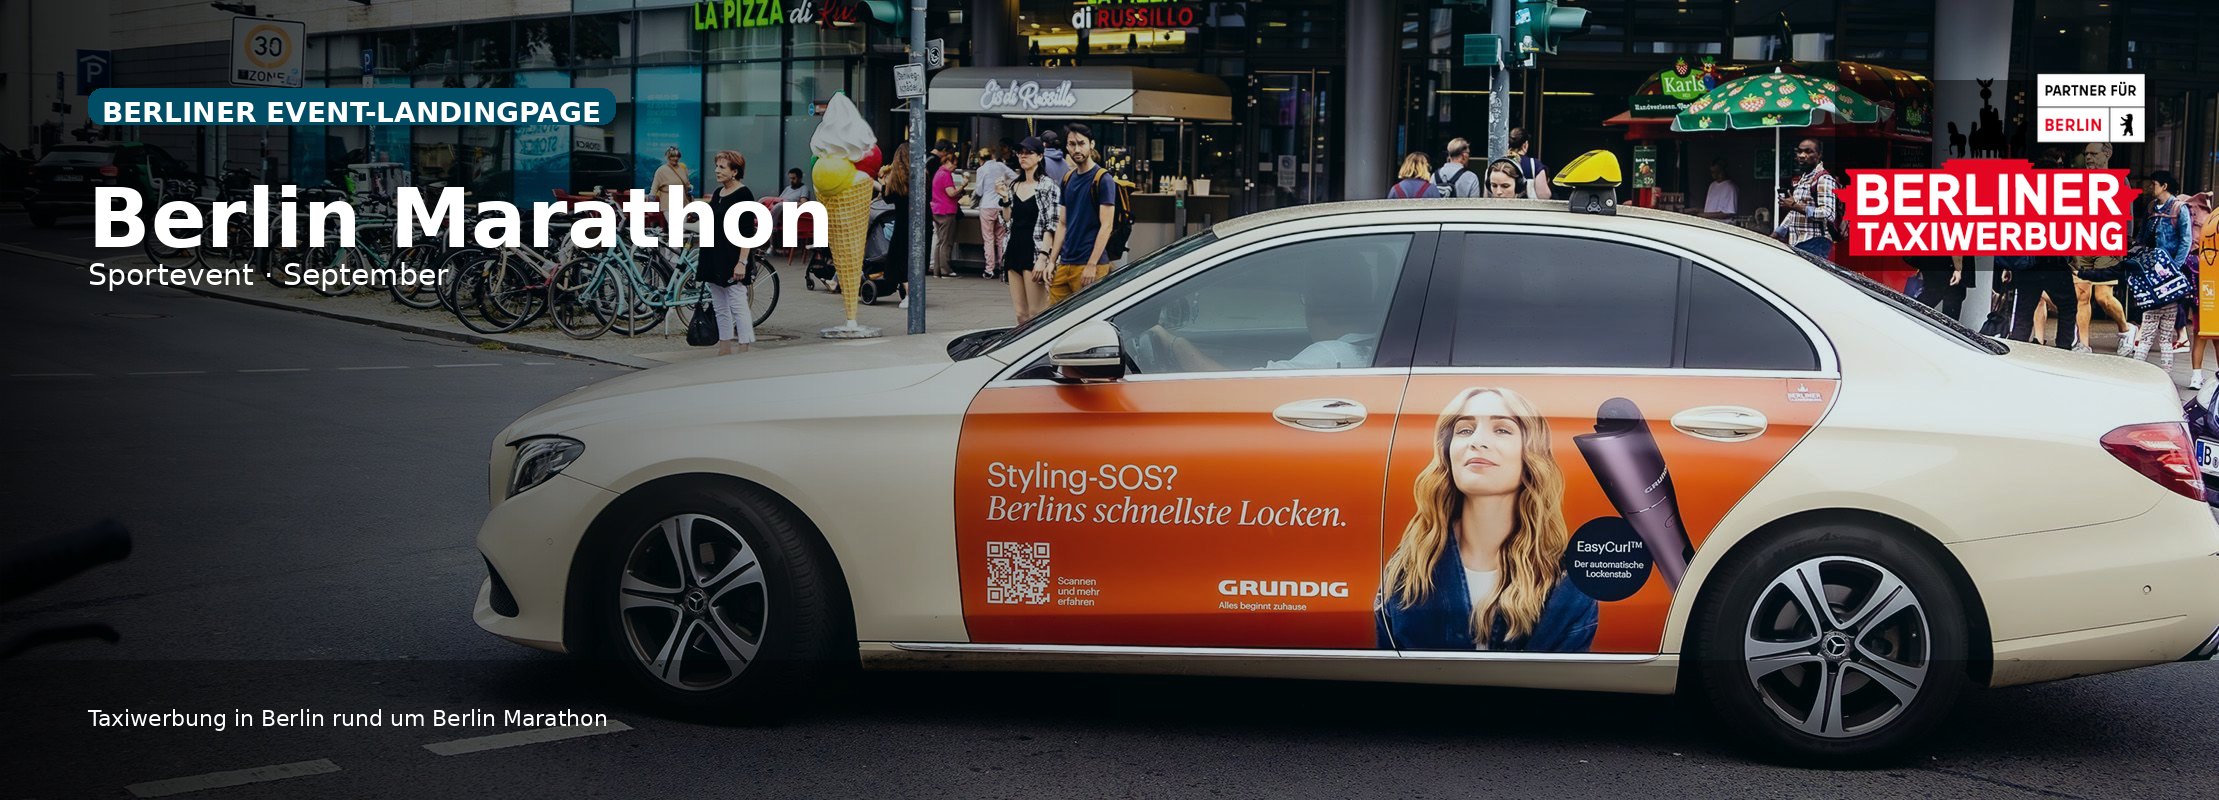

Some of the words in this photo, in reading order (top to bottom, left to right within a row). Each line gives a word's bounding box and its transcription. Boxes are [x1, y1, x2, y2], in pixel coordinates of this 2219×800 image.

[695, 1, 718, 30] LA
[723, 0, 784, 28] PIZZA
[790, 0, 814, 24] di
[1072, 6, 1092, 29] di
[1097, 7, 1194, 27] RUSSILLO
[254, 36, 282, 56] 30
[86, 62, 103, 82] P
[1664, 75, 1705, 93] Karls
[980, 79, 1004, 109] Eis
[1003, 79, 1019, 106] di
[1018, 80, 1077, 109] Russillo
[2203, 445, 2212, 466] B
[987, 460, 1178, 497] Styling-SOS?
[1644, 464, 1668, 494] GRUN
[986, 494, 1088, 524] Berlins
[1092, 496, 1232, 525] schnellste
[1238, 499, 1347, 528] Locken.
[1576, 540, 1643, 556] EasyCurl™
[1574, 560, 1589, 569] Der
[1590, 560, 1644, 569] automatische
[1585, 569, 1632, 579] Lockenstab
[1057, 576, 1097, 586] Scannen
[1218, 579, 1349, 597] GRUNDIG
[1057, 586, 1075, 596] und
[1076, 586, 1100, 596] mehr
[1057, 597, 1095, 607] erfahren
[1218, 601, 1239, 610] Alles
[1240, 602, 1271, 612] beginnt
[1273, 602, 1307, 612] zuhause
